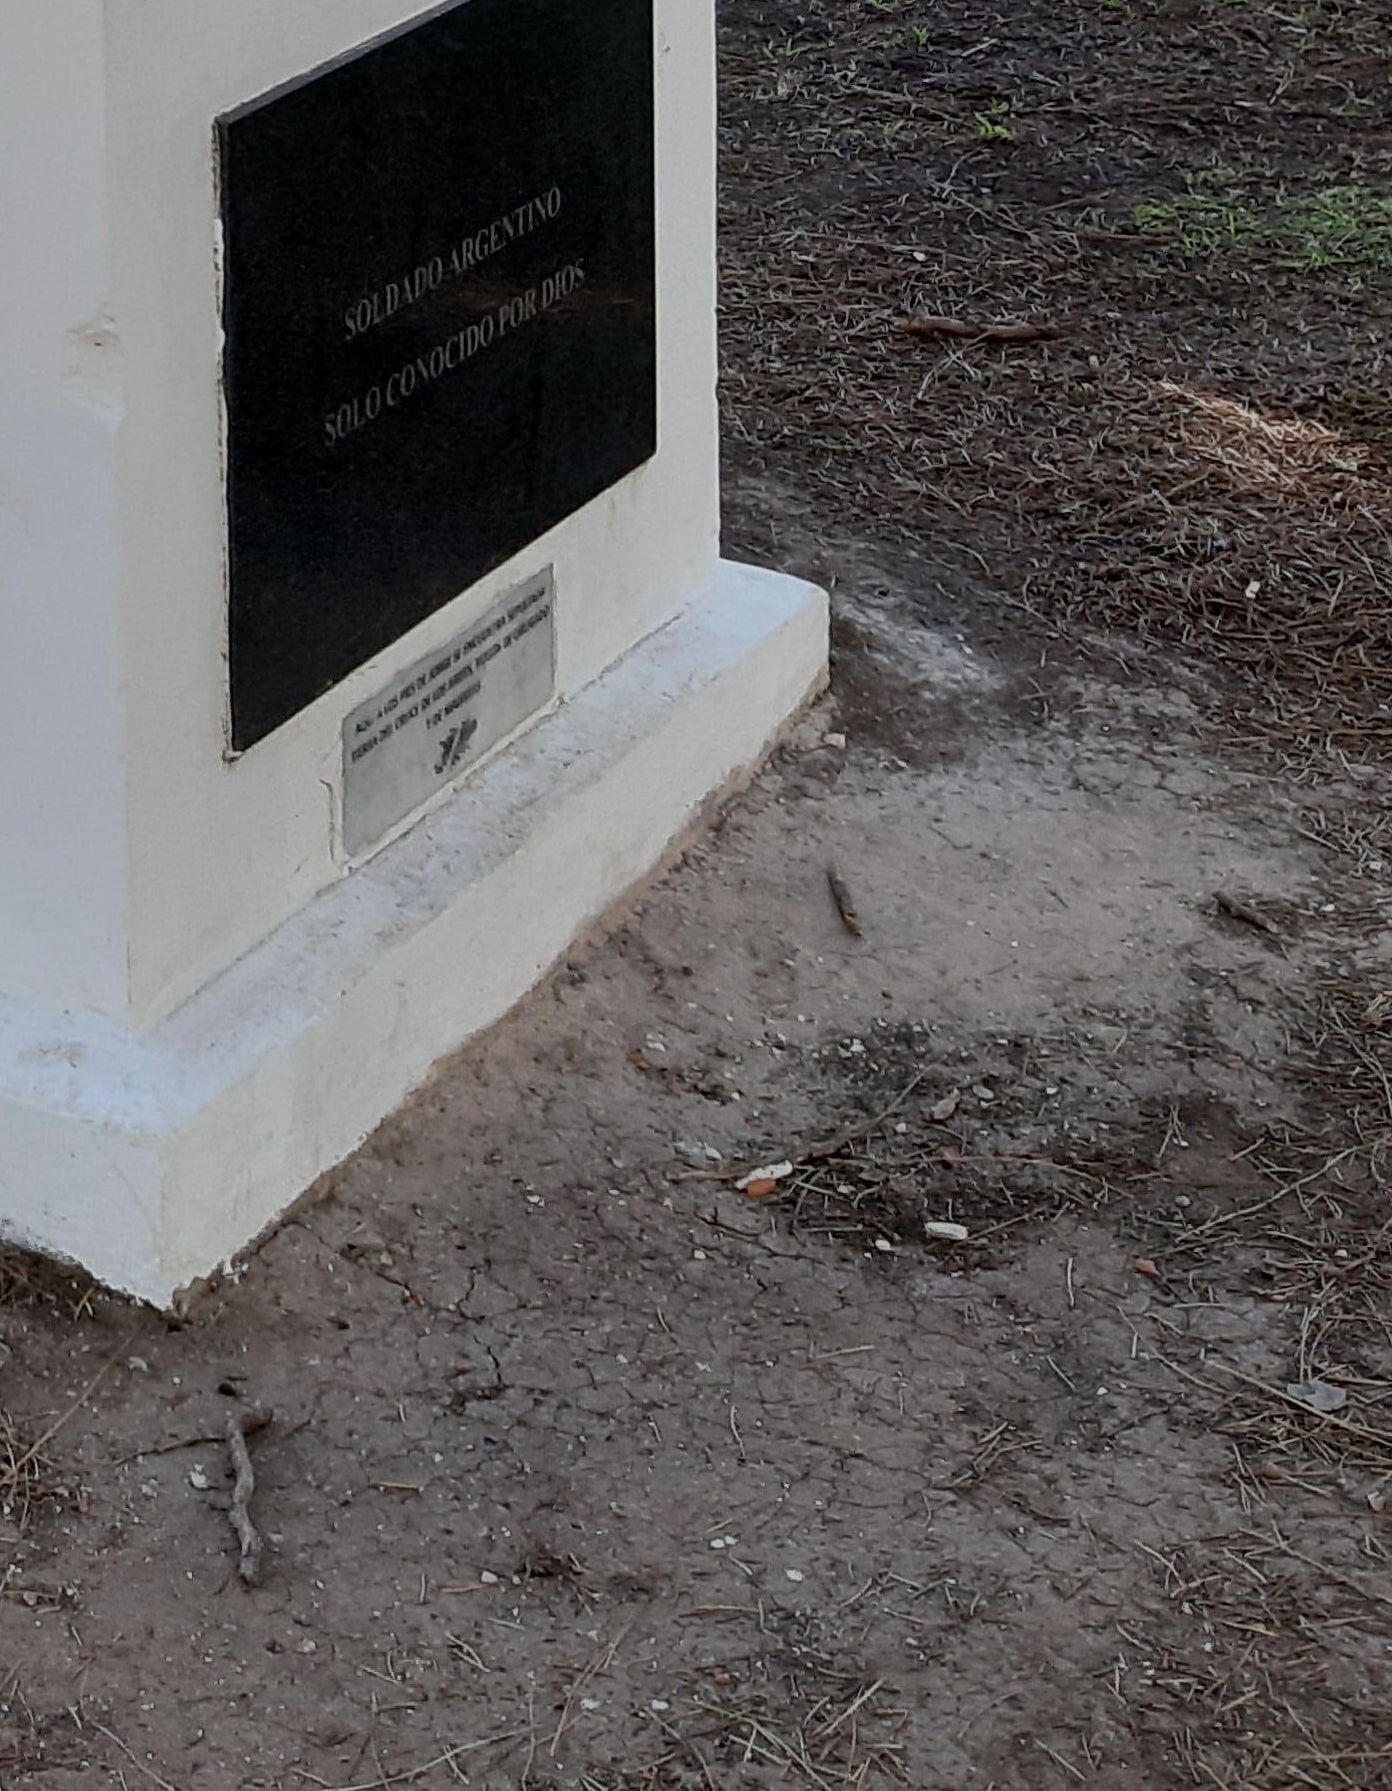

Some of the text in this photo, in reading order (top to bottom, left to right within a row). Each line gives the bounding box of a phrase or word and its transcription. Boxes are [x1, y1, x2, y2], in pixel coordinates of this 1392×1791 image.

[345, 185, 561, 340] SOLDADO ARGENTINO
[323, 258, 586, 447] SOLO CONOCIDO POR DIOS
